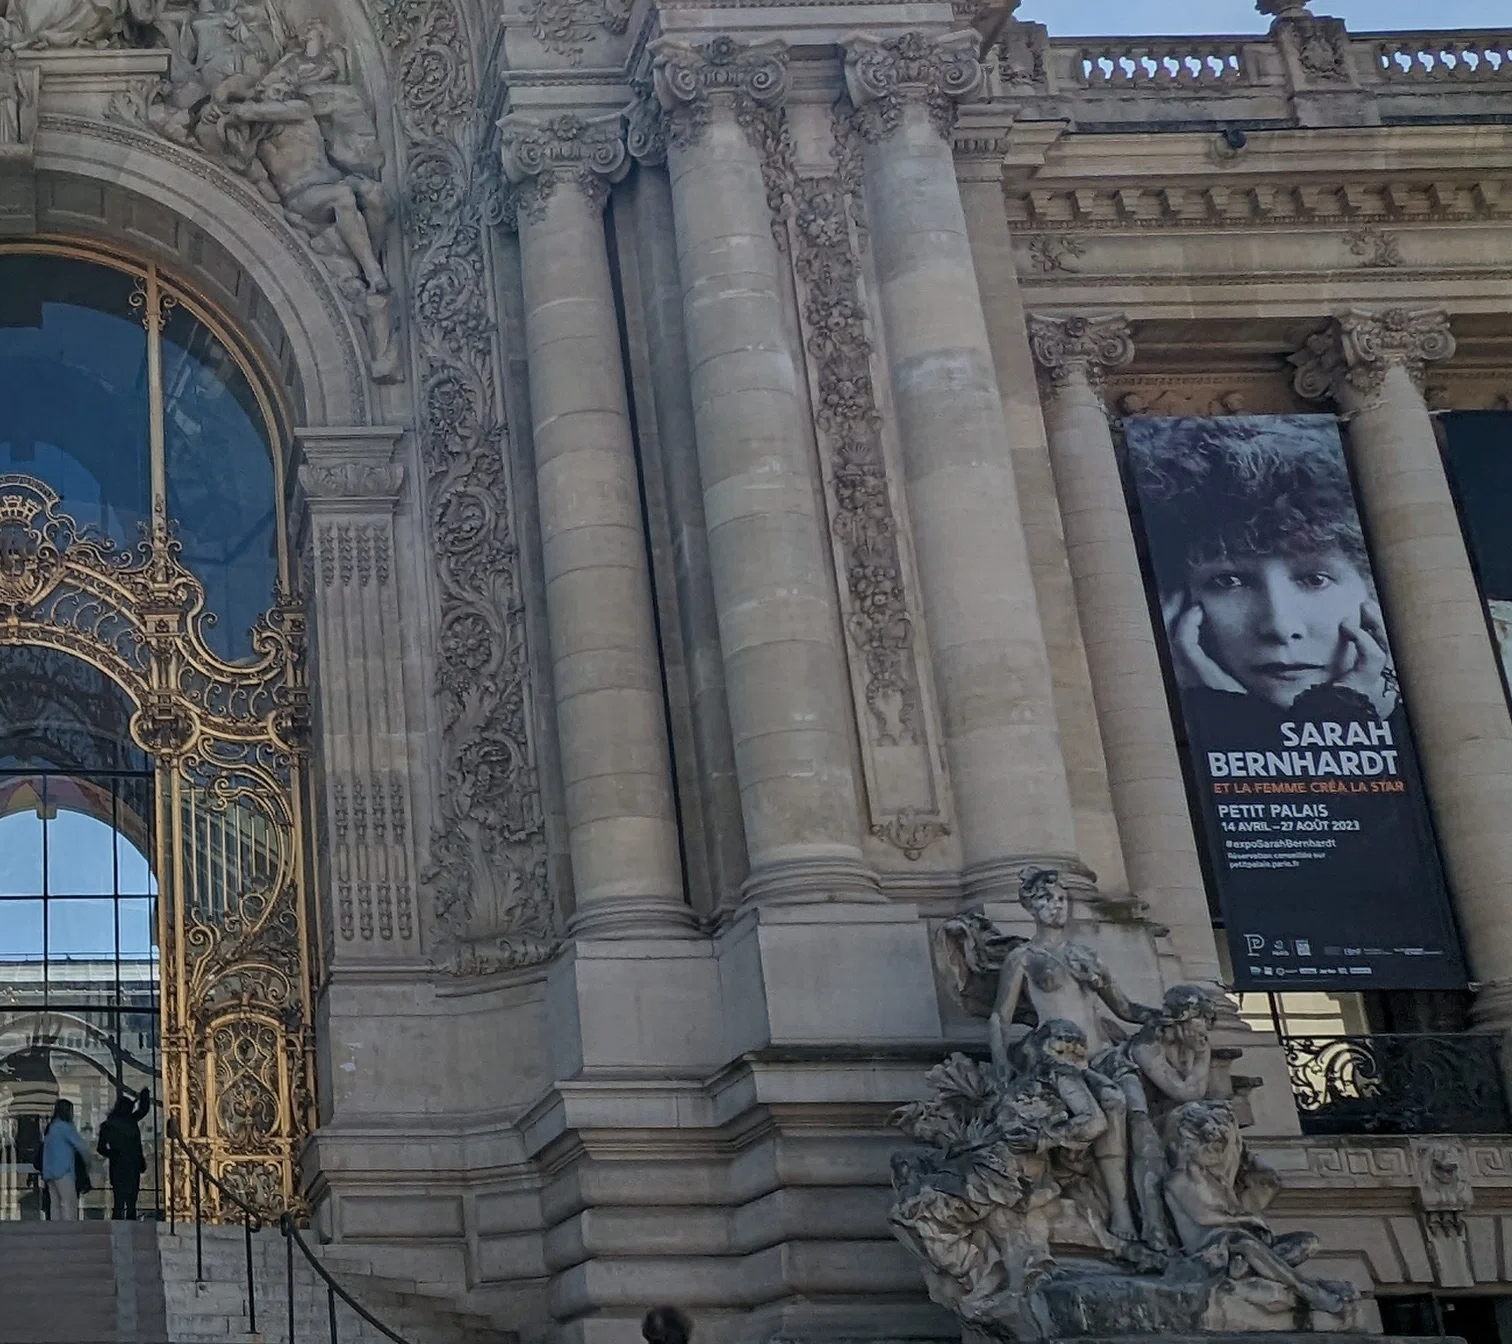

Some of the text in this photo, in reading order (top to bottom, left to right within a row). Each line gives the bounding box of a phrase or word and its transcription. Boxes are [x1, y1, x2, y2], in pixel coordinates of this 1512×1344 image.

[1280, 720, 1394, 747] SARAH
[1207, 750, 1398, 777] BERNHARDT
[1213, 779, 1404, 794] ET LA FEMME CRÉA LA STAR
[1218, 804, 1329, 818] PETIT PALAIS
[1221, 822, 1236, 832] 14
[1238, 821, 1271, 831] AVRIL
[1280, 821, 1293, 831] 27
[1296, 819, 1329, 831] AOÛT
[1332, 820, 1361, 831] 2023
[1226, 839, 1337, 850] #expoSarahBernhardt
